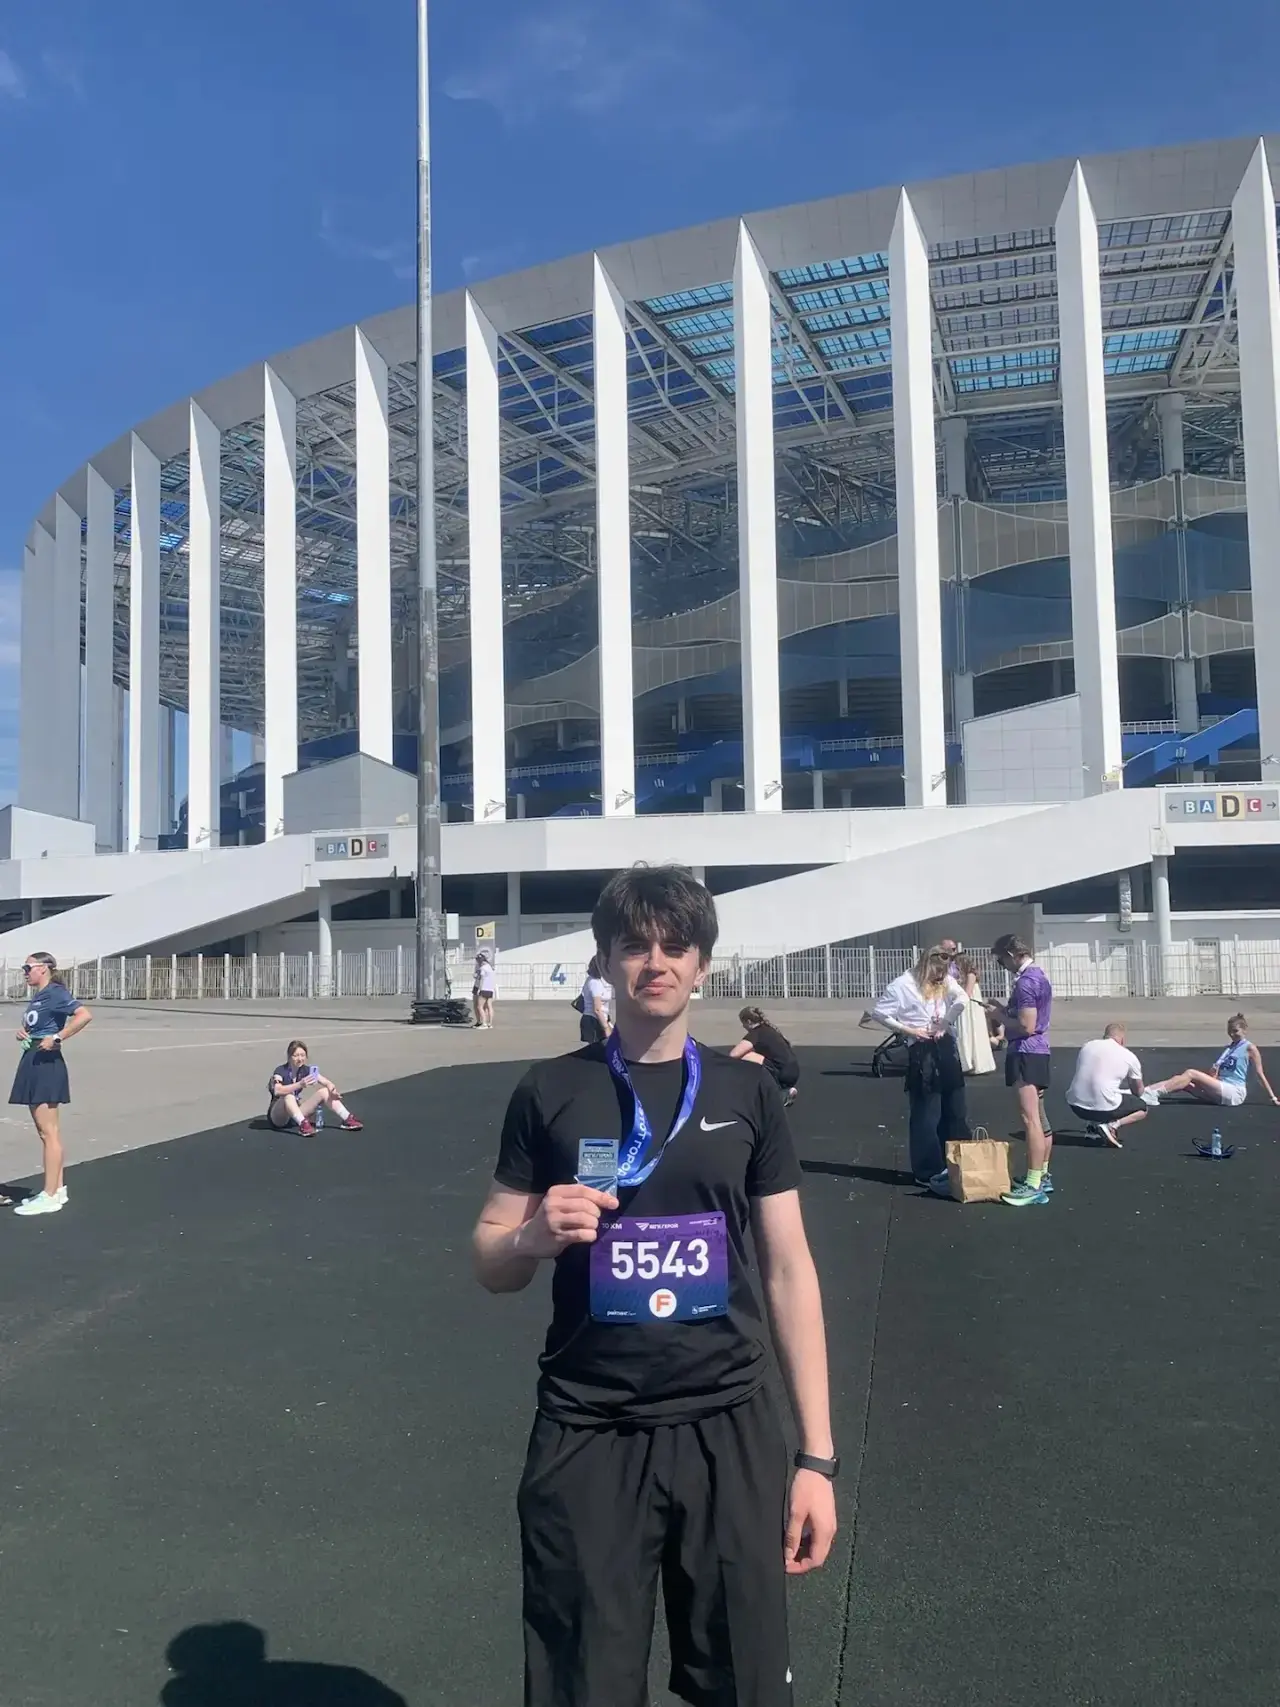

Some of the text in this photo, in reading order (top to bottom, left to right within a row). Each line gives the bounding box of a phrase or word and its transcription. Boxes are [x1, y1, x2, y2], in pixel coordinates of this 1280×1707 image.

[1185, 795, 1260, 817] B A D C
[327, 838, 376, 856] B A D C
[476, 927, 485, 938] D
[550, 963, 566, 985] 4
[617, 1139, 643, 1177] ГОРОД
[611, 1239, 709, 1280] 5543
[656, 1295, 672, 1312] F
